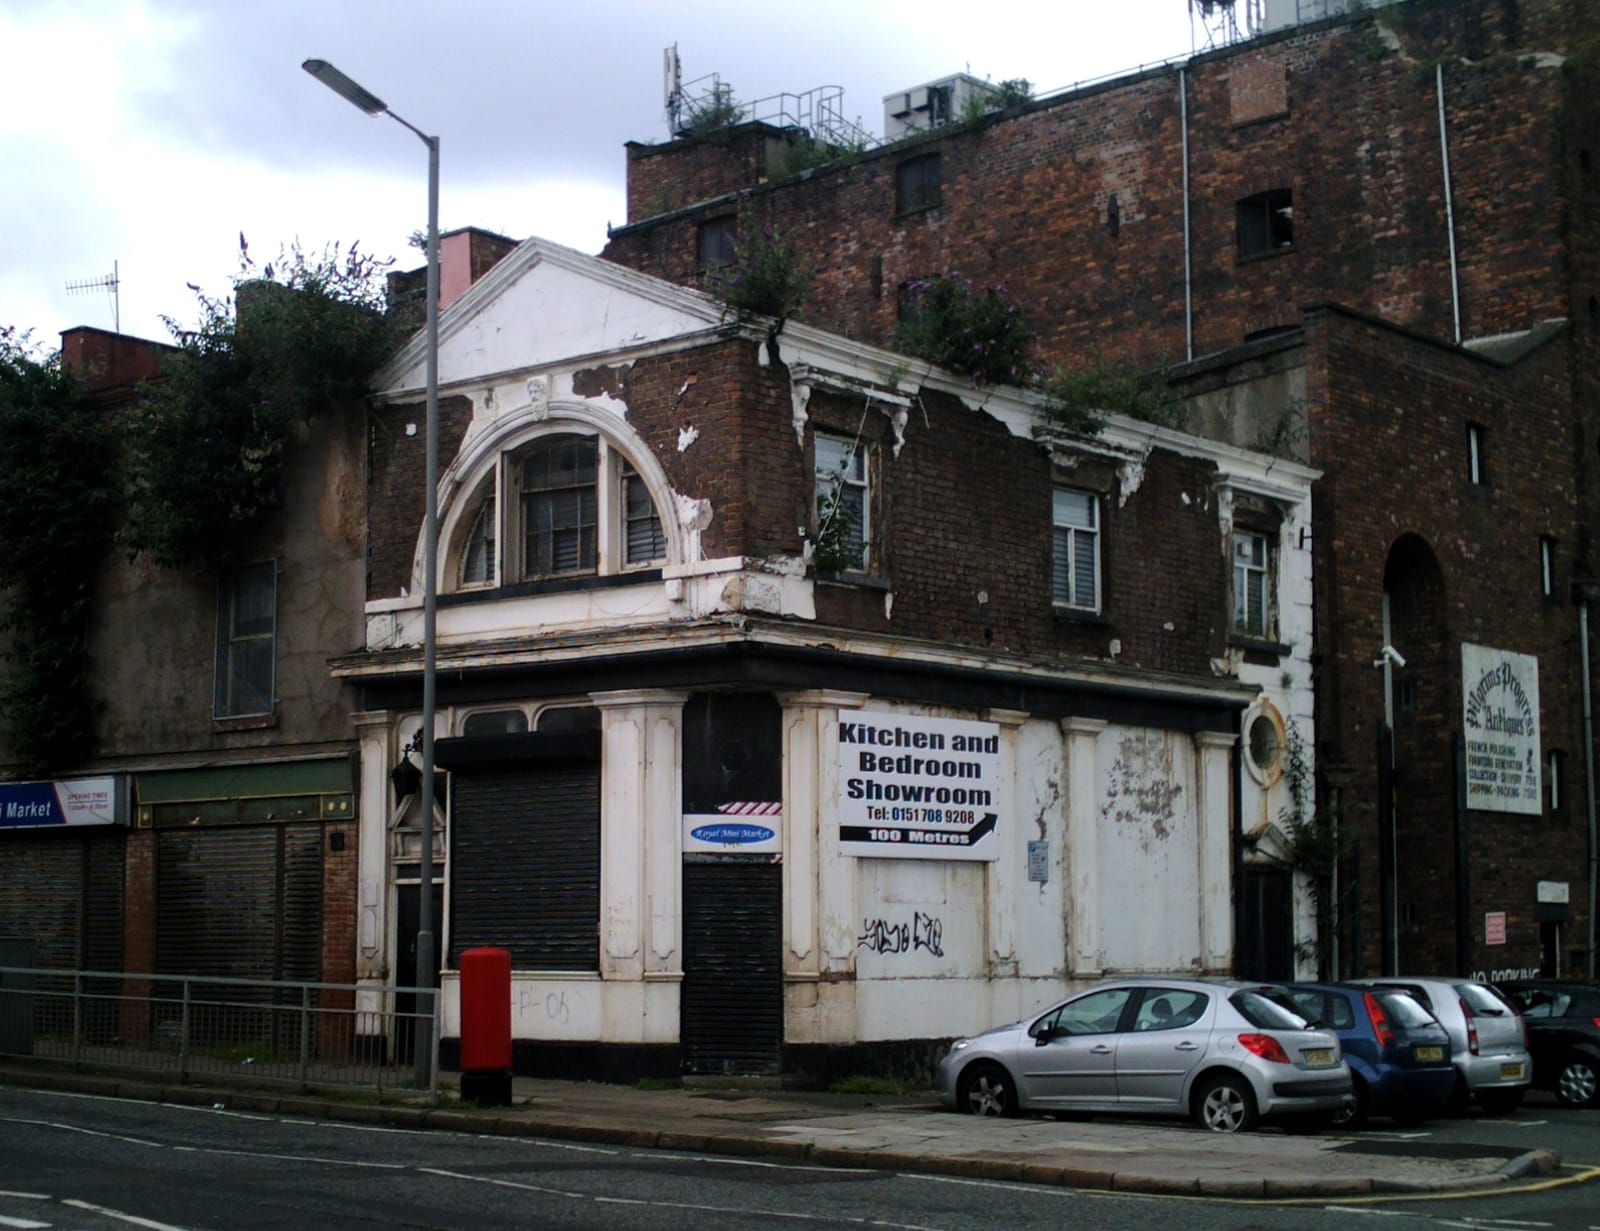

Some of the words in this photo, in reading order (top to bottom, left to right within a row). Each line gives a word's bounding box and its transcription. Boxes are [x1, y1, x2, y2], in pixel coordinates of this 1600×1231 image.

[1484, 705, 1524, 738] Antiques
[839, 722, 945, 749] Kitchen
[951, 734, 999, 754] and
[859, 751, 982, 779] Bedroom
[847, 778, 991, 806] Showroom
[6, 801, 52, 818] Market
[867, 806, 890, 820] Tel:
[892, 807, 919, 822] 0151
[922, 809, 943, 823] 708
[945, 810, 975, 824] 9208
[695, 828, 720, 840] Royal
[720, 828, 740, 838] Mini
[740, 828, 770, 839] Market
[868, 829, 902, 841] 100
[908, 830, 970, 844] Metres
